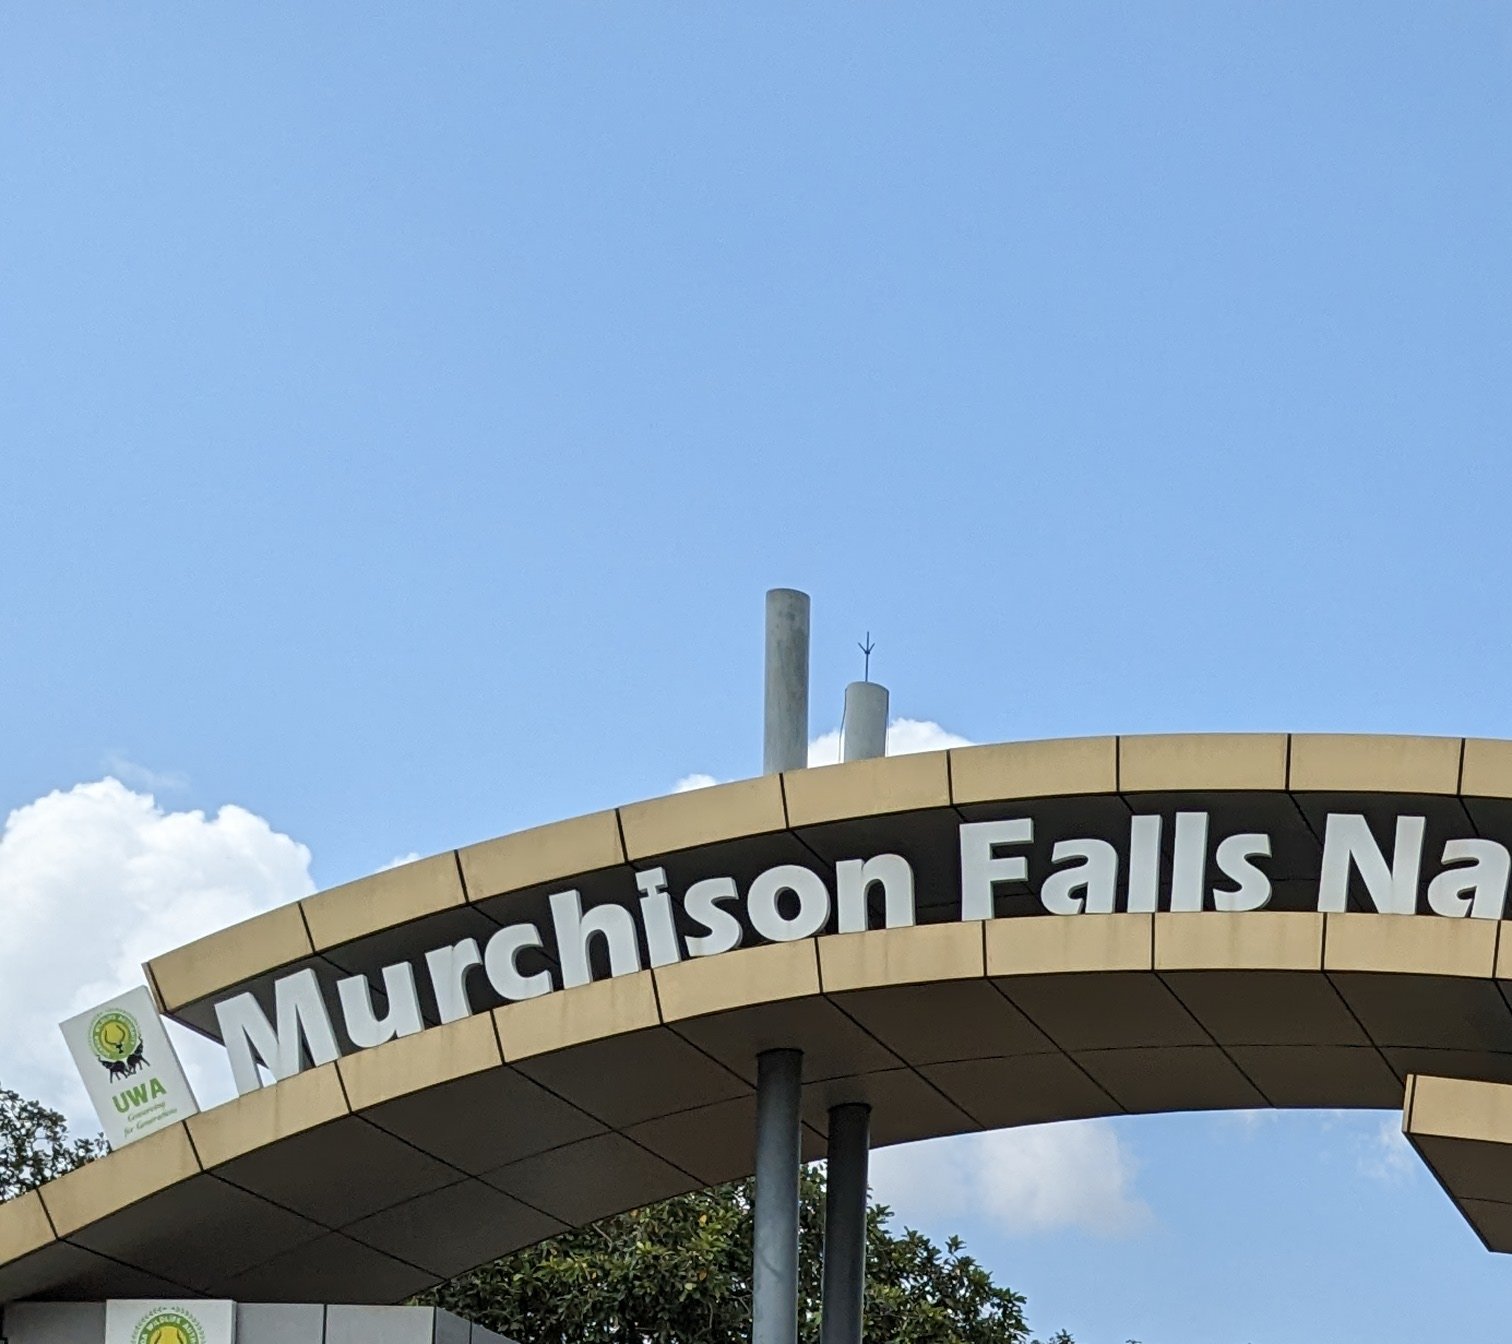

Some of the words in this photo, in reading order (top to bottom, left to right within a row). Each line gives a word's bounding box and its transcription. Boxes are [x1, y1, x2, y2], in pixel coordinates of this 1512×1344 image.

[214, 852, 915, 1096] Murchison
[959, 811, 1273, 919] Falls
[112, 1077, 167, 1113] UWA
